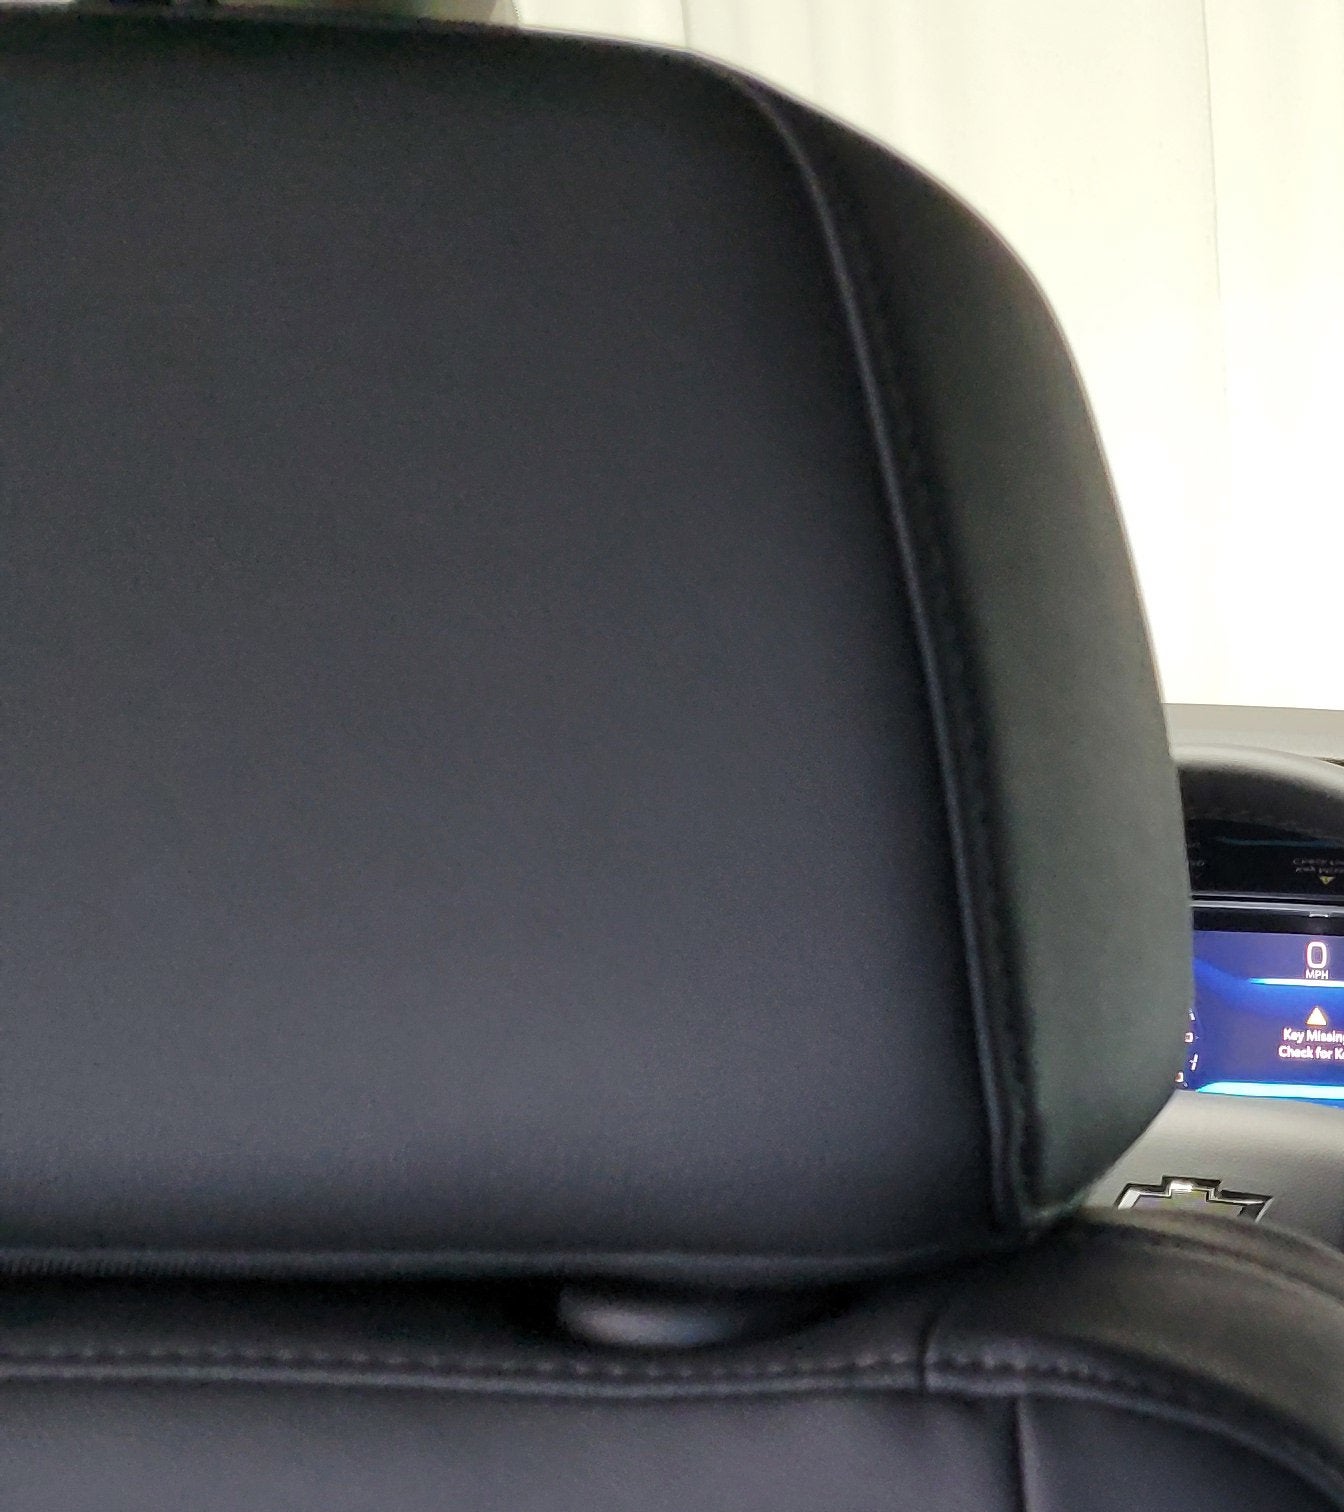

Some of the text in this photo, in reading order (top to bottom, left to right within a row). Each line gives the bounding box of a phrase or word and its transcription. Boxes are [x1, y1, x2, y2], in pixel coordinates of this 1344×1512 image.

[1306, 941, 1328, 969] 0
[1305, 969, 1329, 980] MPH
[1283, 1027, 1304, 1043] Key
[1278, 1045, 1313, 1059] Check
[1315, 1046, 1333, 1059] for
